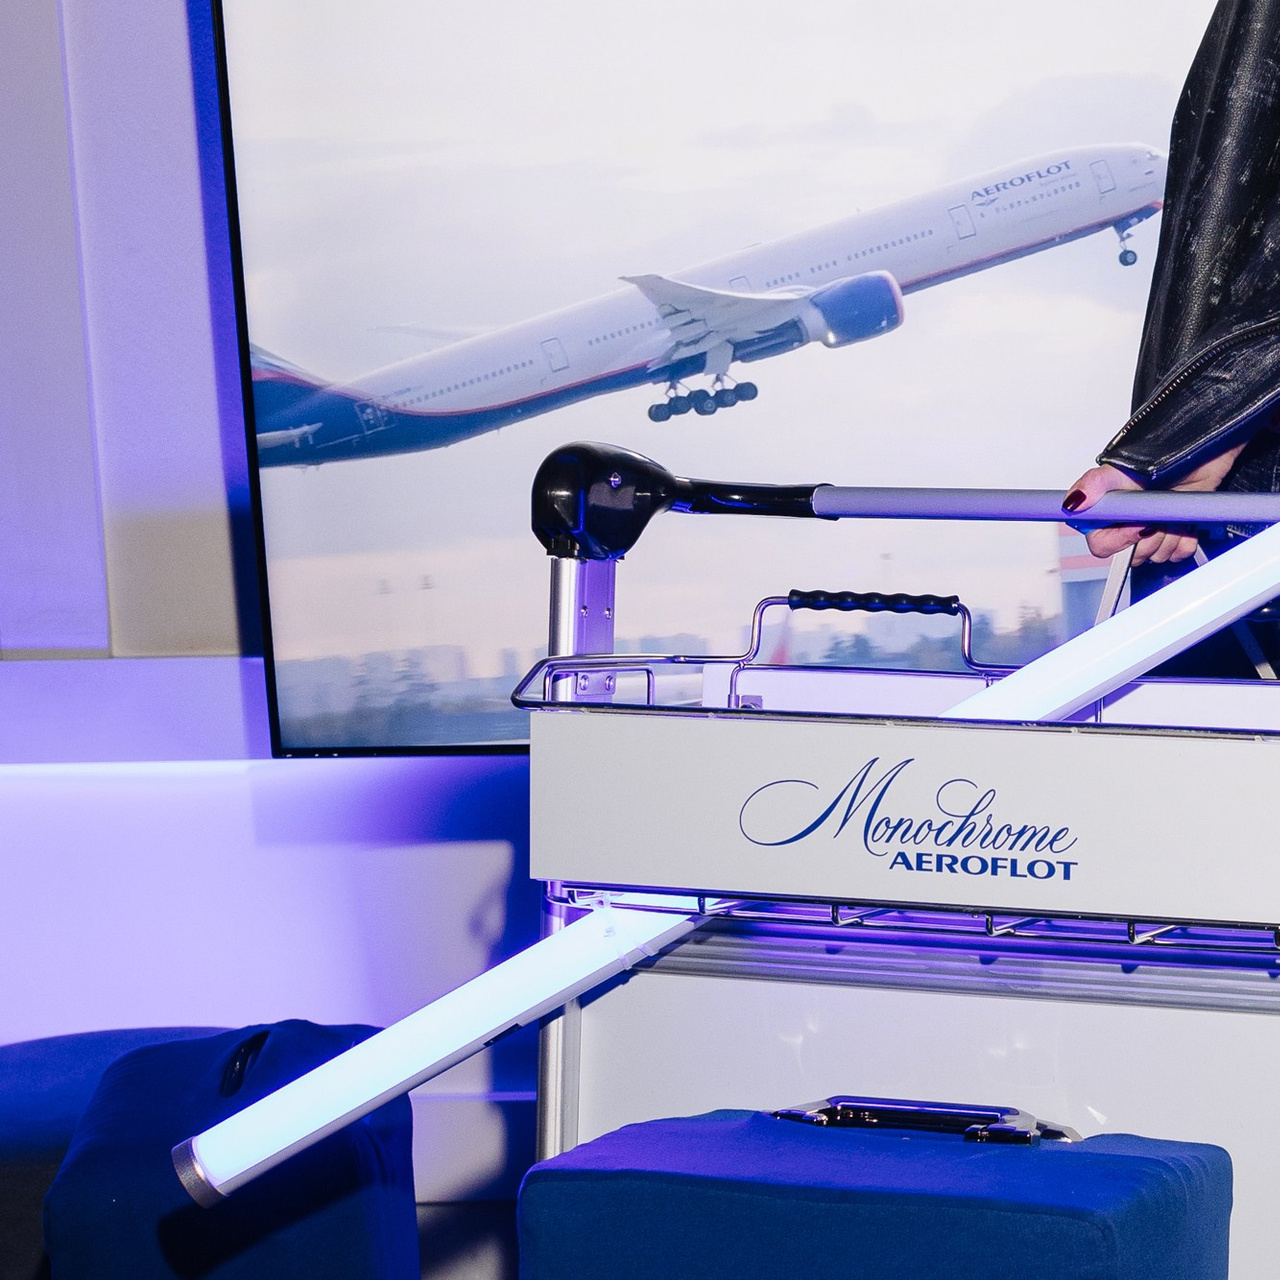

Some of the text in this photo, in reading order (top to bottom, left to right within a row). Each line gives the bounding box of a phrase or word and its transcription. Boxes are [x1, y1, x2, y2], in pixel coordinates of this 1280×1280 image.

[971, 160, 1071, 201] AEROFLOT
[739, 756, 1078, 857] Monochrome
[888, 851, 1079, 882] AEROFLOT
